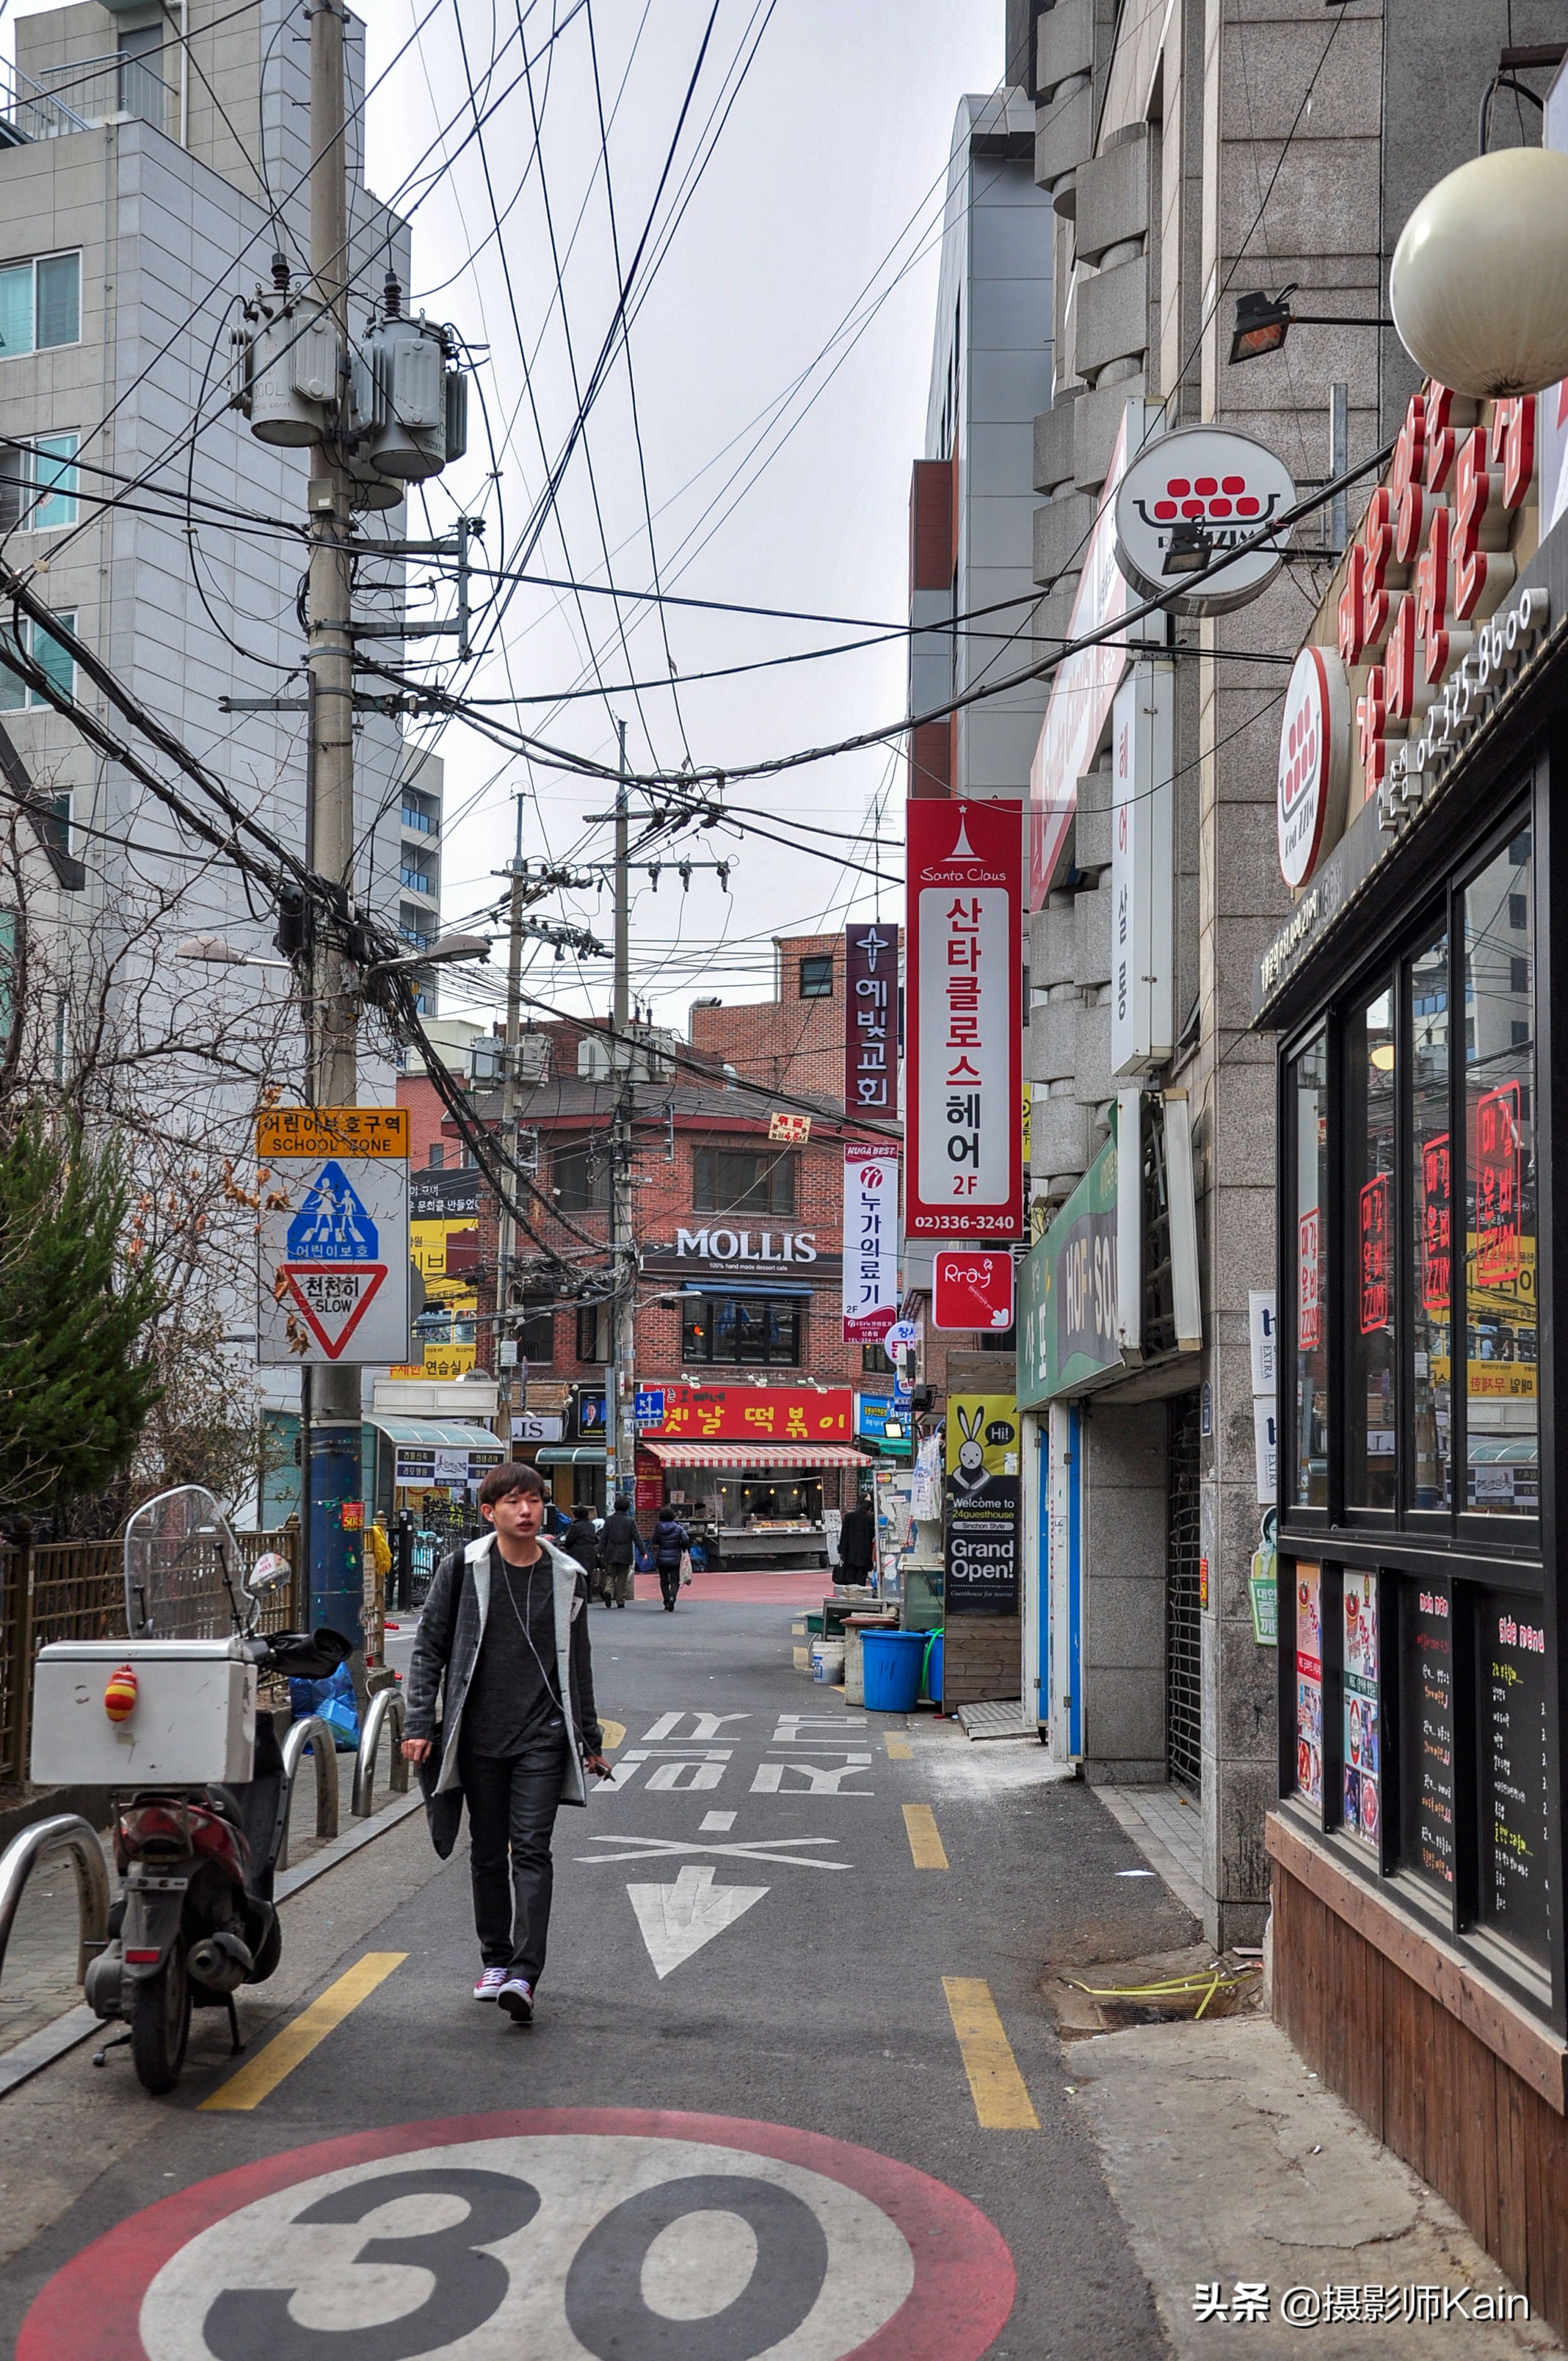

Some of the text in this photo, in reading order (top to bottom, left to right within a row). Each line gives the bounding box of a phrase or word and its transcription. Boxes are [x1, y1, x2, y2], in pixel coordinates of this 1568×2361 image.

[920, 866, 1006, 881] Santa Claus
[856, 979, 887, 1106] 예빛교회
[264, 1115, 400, 1134] 어린이보호구역
[272, 1139, 391, 1151] SCHOOL ZONE
[953, 1175, 978, 1195] 2F
[915, 1216, 1015, 1230] 02)336-3240
[296, 1244, 369, 1258] 어린이보호
[675, 1227, 817, 1263] MOLLIS
[860, 1192, 882, 1305] 누가의료기
[945, 1263, 991, 1288] Rray
[305, 1275, 359, 1297] 천천히
[315, 1299, 352, 1313] SLOW
[846, 1305, 858, 1313] 2F
[425, 1360, 461, 1375] 연습실
[1263, 1345, 1272, 1379] EXTRA
[663, 1405, 845, 1438] 옛날 떡볶이
[991, 1427, 1009, 1440] Hi!
[953, 1496, 1015, 1509] Welcome to
[952, 1509, 1015, 1520] 24guesthouse
[990, 1523, 1006, 1531] Style
[951, 1539, 1014, 1558] Grand
[951, 1559, 1015, 1581] Open!
[984, 1590, 993, 1598] for
[1499, 1614, 1545, 1653] Side menu
[641, 1711, 868, 1743] 금지
[590, 1749, 875, 1796] 진입
[202, 2168, 830, 2361] 30
